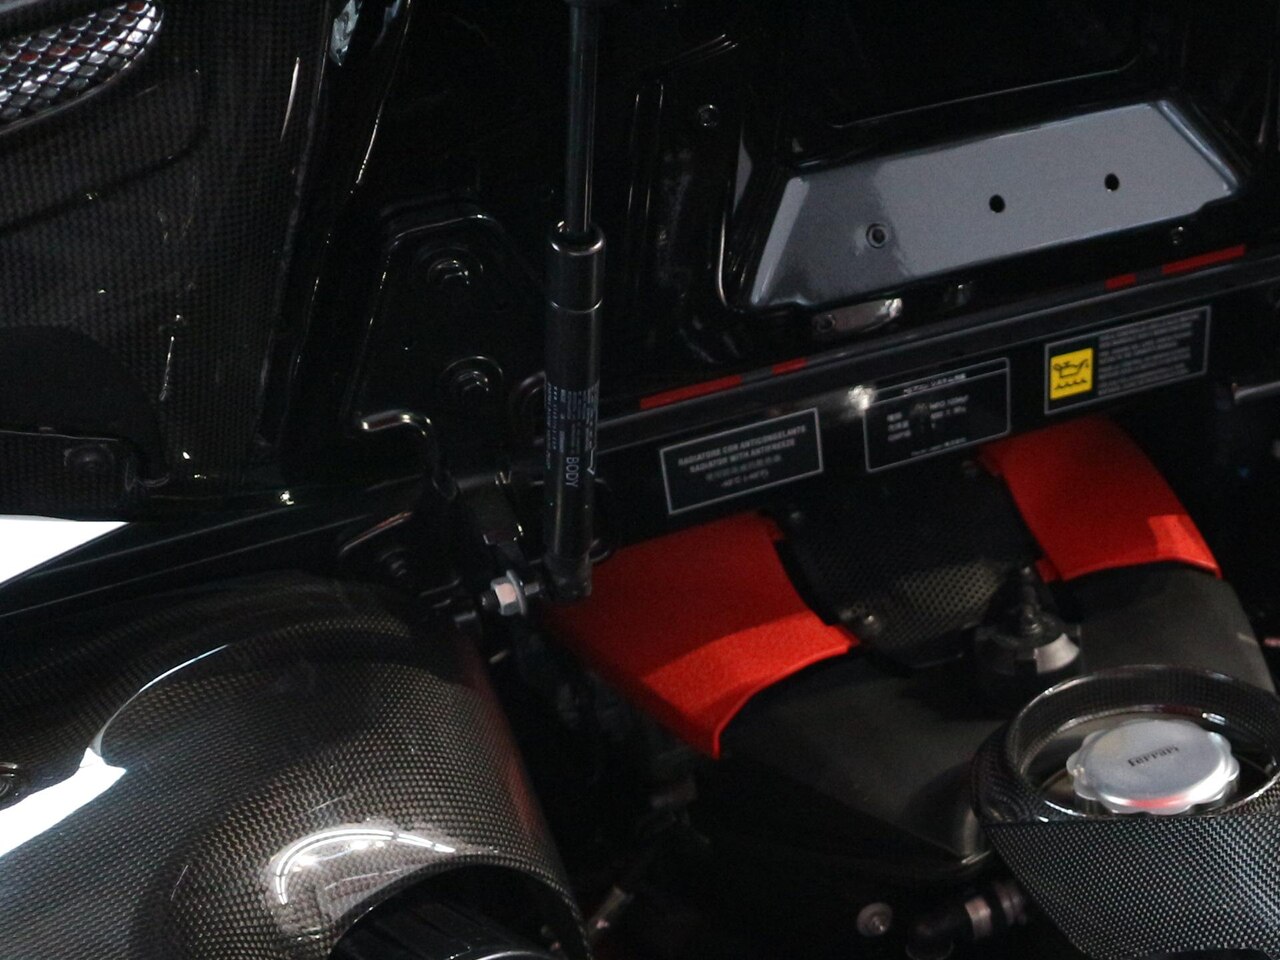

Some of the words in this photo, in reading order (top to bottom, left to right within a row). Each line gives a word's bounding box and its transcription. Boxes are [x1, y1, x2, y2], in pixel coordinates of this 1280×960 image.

[722, 443, 738, 454] CON
[566, 456, 579, 488] BODY
[1128, 745, 1179, 767] Ferrari
